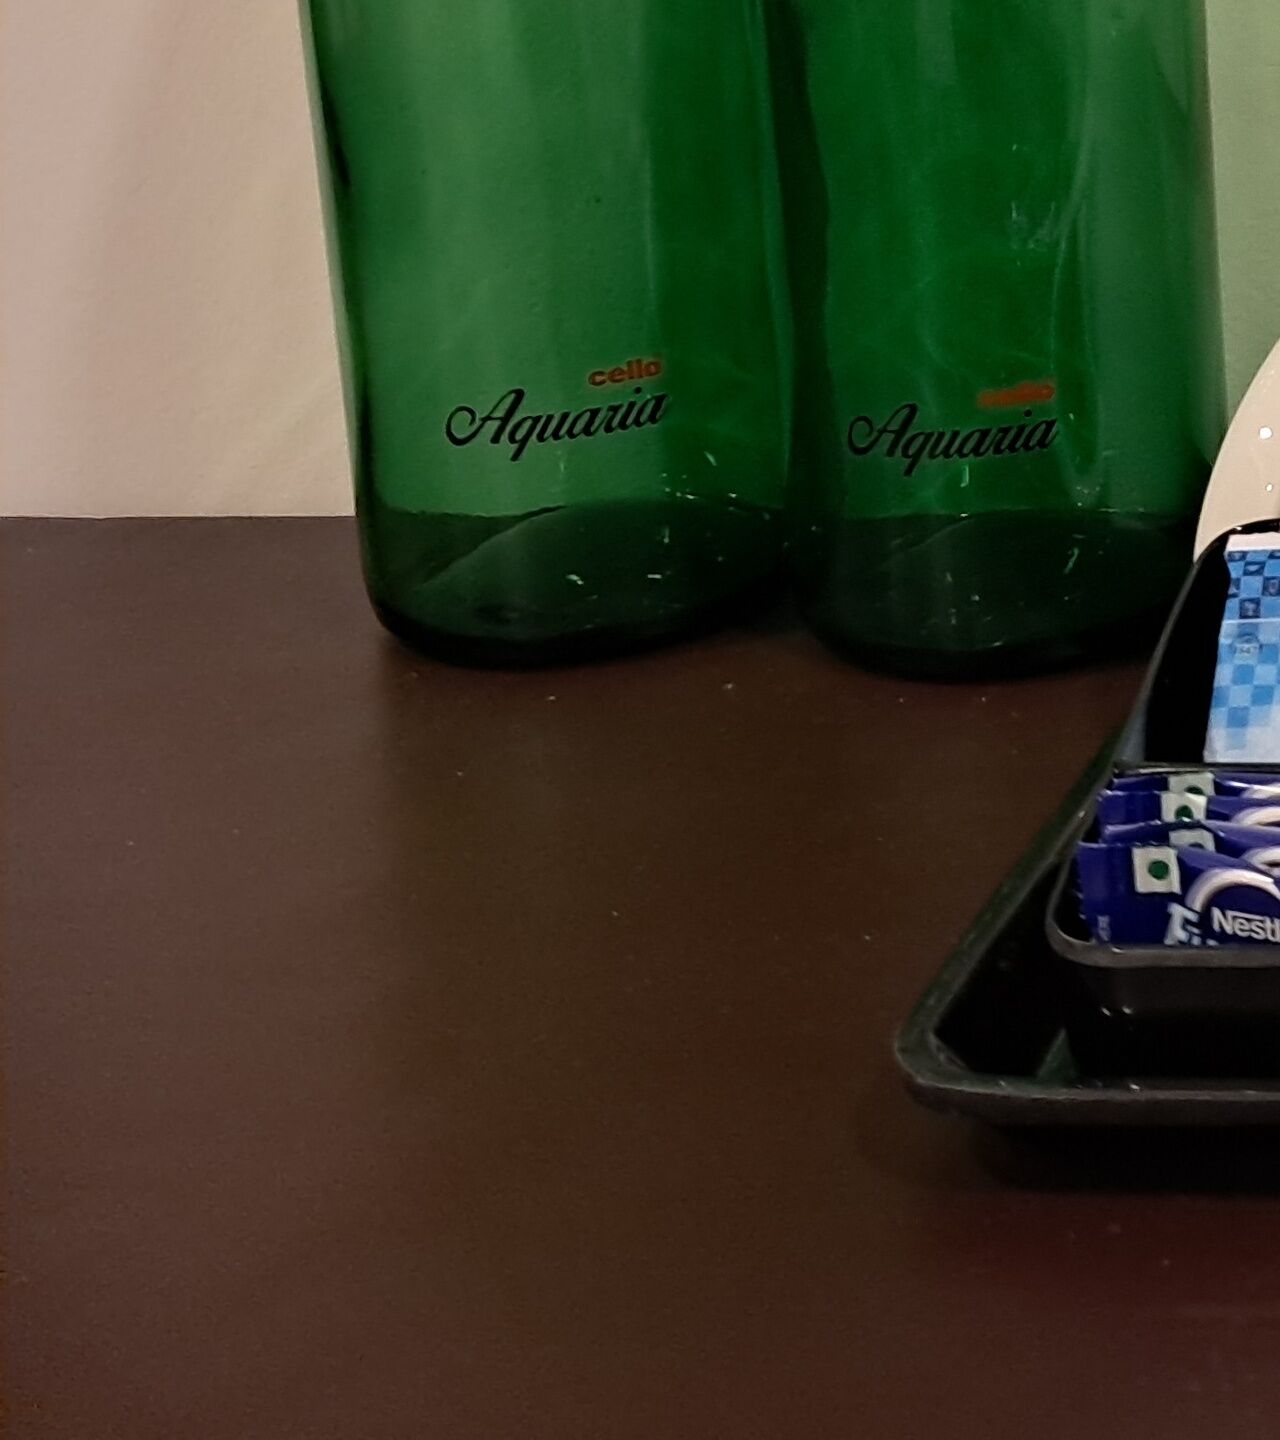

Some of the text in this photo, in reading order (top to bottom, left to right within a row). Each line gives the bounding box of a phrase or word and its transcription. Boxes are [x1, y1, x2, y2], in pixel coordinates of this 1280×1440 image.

[588, 359, 662, 386] cello
[446, 388, 669, 462] Aquaria
[848, 403, 1058, 477] Aquaria
